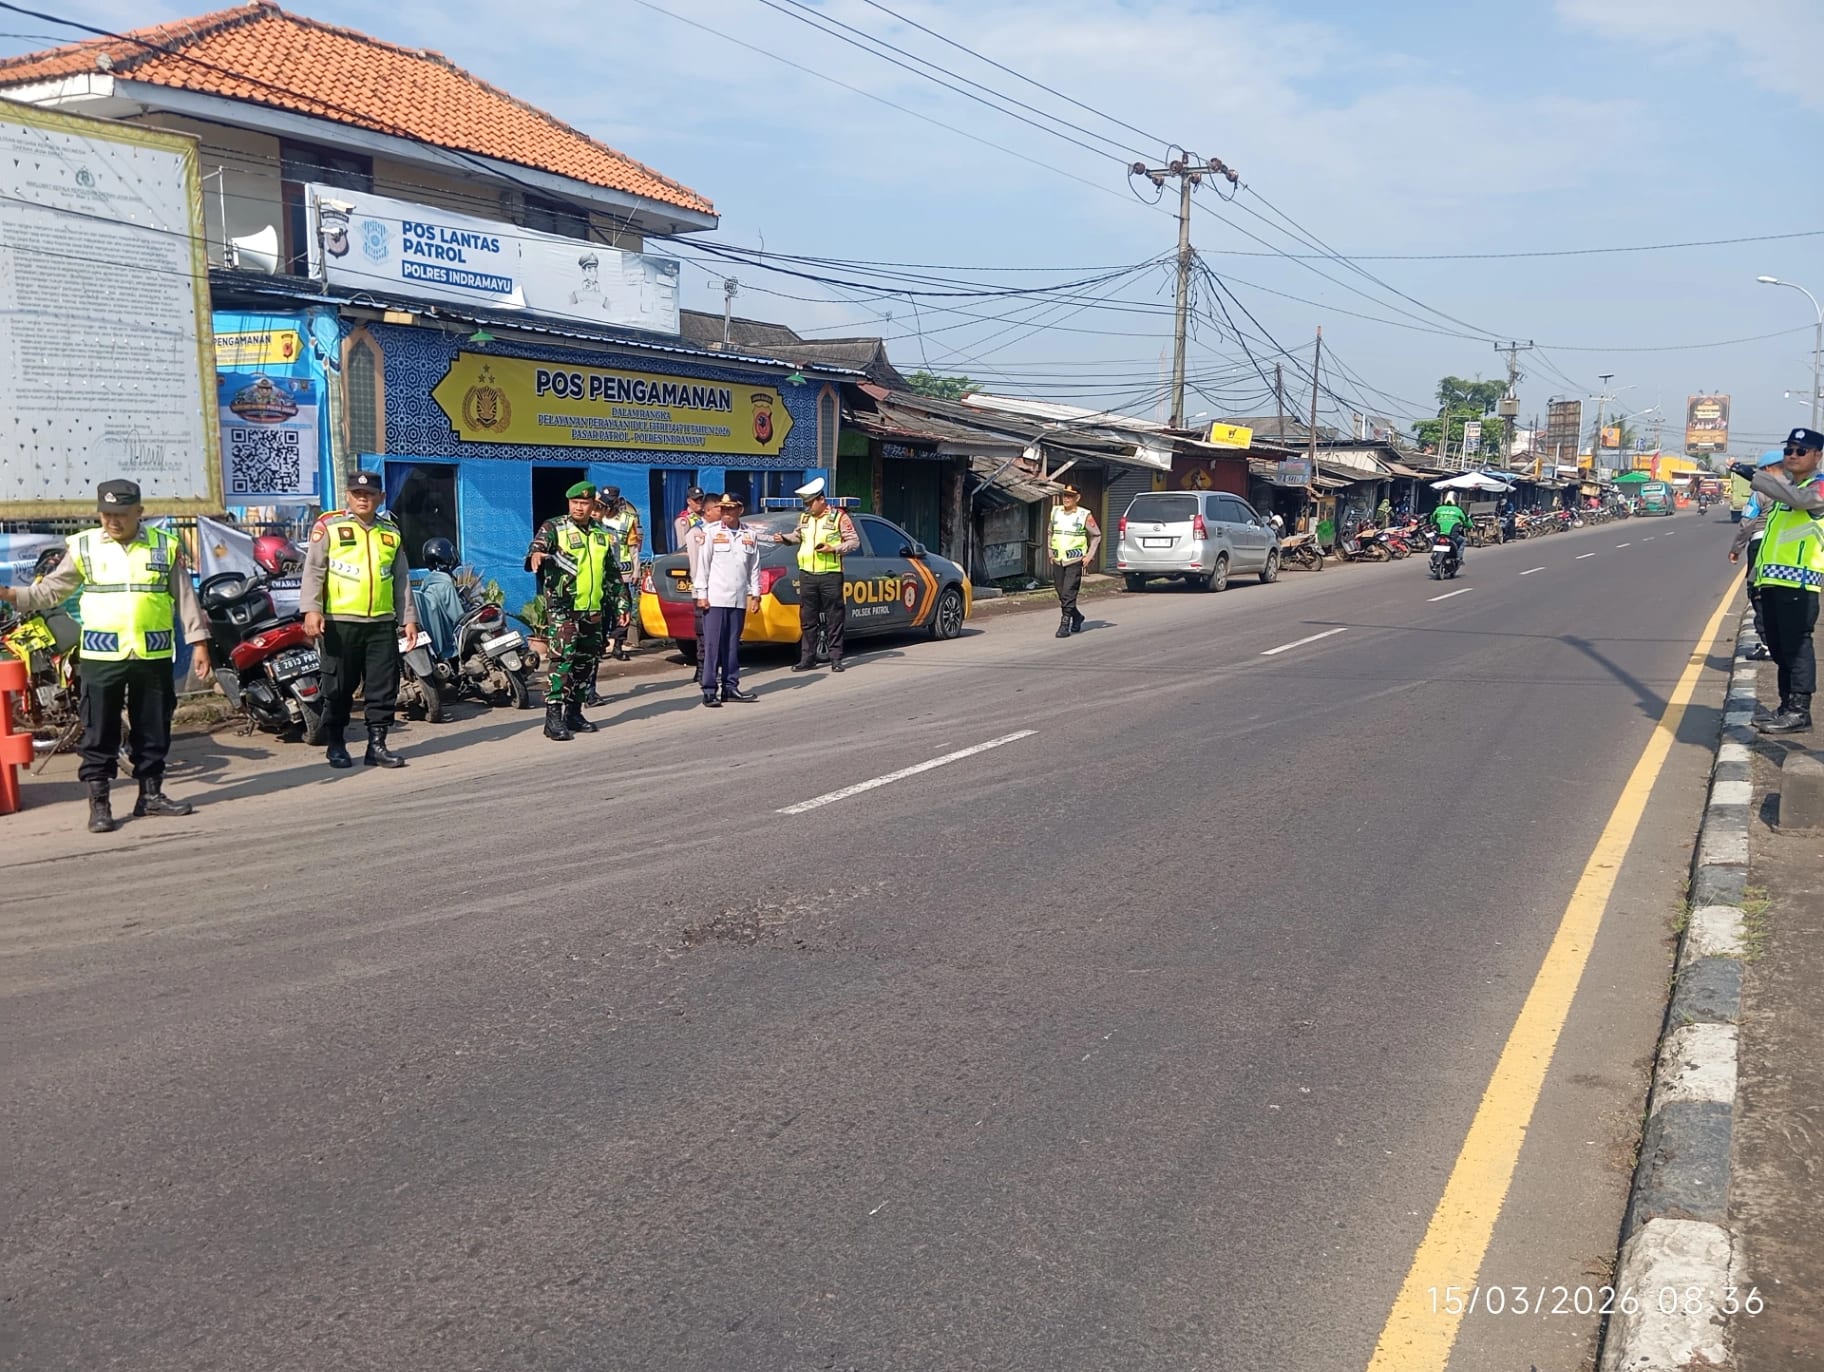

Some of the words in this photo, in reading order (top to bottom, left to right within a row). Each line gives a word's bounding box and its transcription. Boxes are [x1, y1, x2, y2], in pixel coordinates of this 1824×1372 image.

[402, 220, 436, 241] POS
[440, 228, 500, 253] LANTAS
[403, 238, 467, 263] PATROL
[404, 263, 447, 282] POLRES
[449, 271, 511, 292] INDRAMAYU
[213, 334, 271, 346] PENGAMANAN
[536, 369, 584, 399] POS
[589, 375, 732, 412] PENGAMANAN
[611, 407, 640, 419] DALAM
[640, 409, 672, 421] RANGKA
[572, 429, 599, 441] PASAR
[600, 431, 630, 443] PATROL
[634, 432, 663, 444] POLRES
[843, 579, 901, 605] POLISI
[852, 607, 871, 617] POLSEK
[872, 606, 890, 615] PATROL
